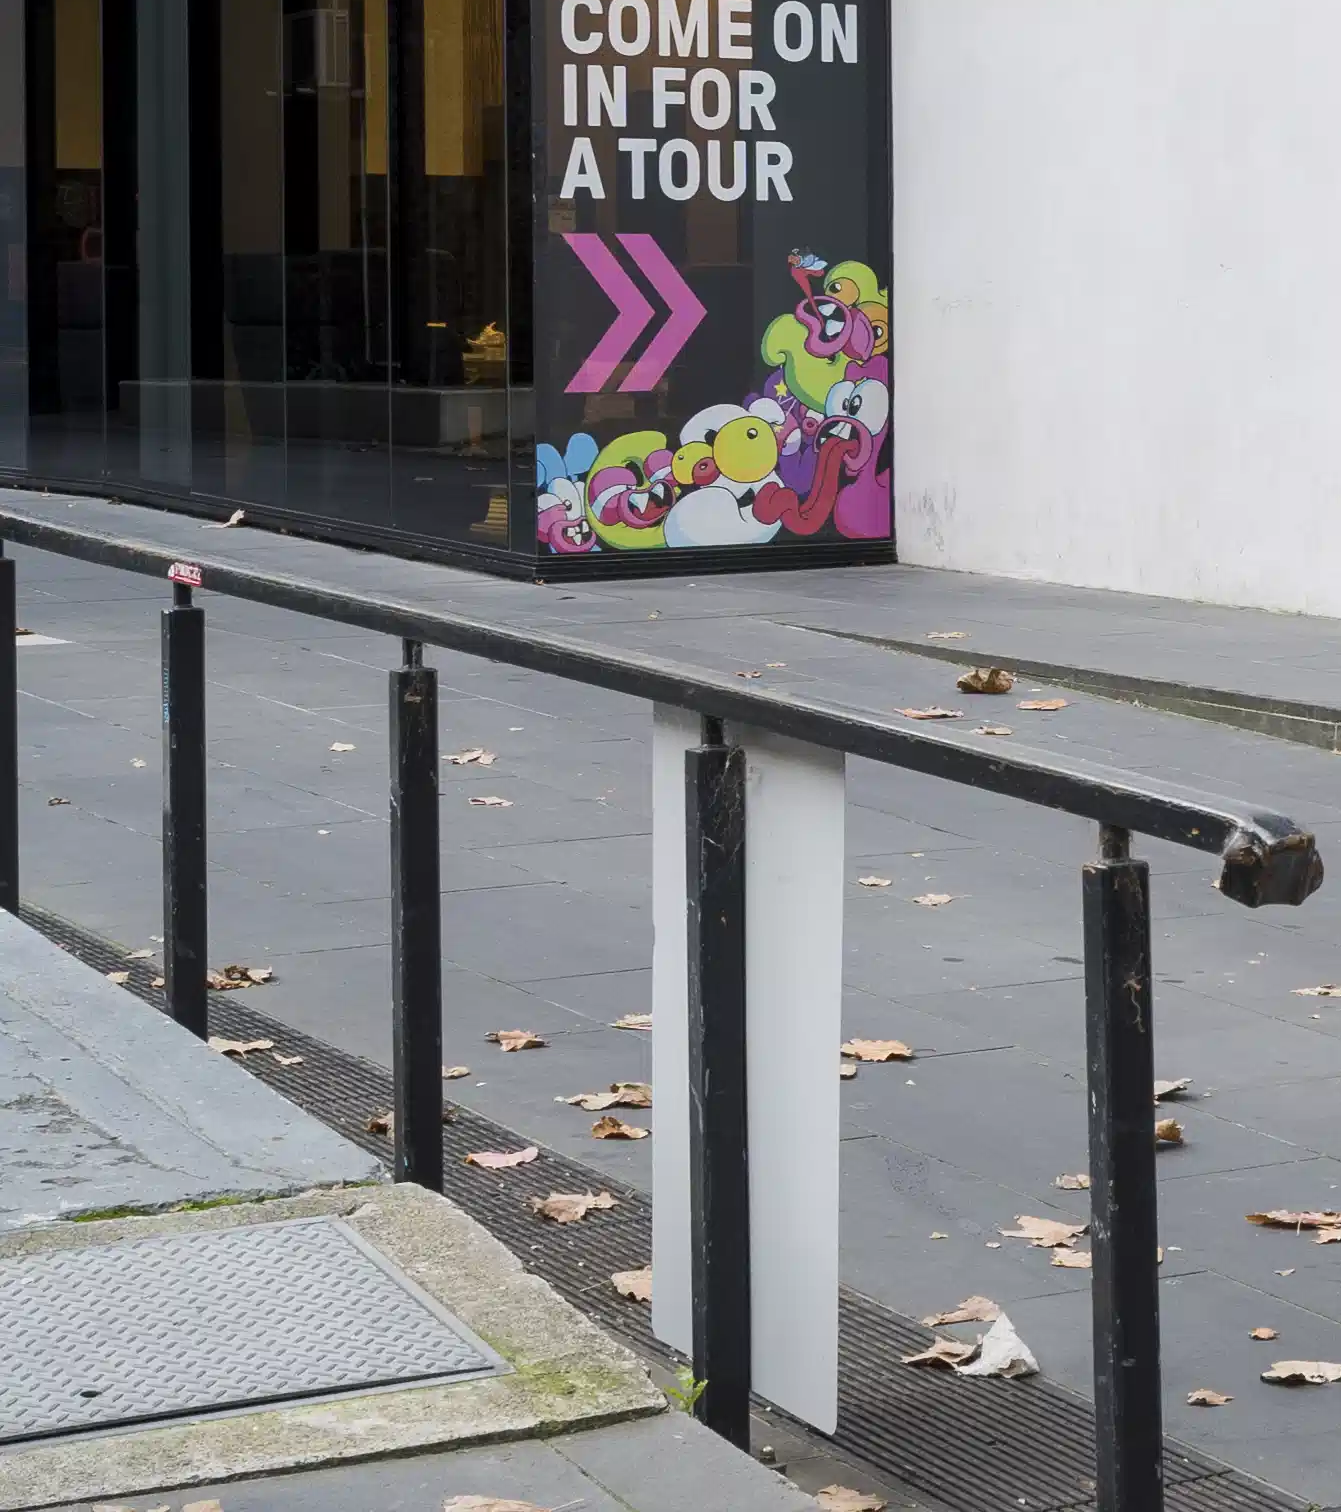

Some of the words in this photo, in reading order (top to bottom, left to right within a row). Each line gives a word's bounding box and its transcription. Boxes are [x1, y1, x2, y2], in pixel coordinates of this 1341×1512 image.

[773, 0, 858, 64] ON
[563, 64, 627, 127] IN
[652, 66, 777, 130] FOR
[559, 137, 606, 200] A
[618, 137, 794, 202] TOUR
